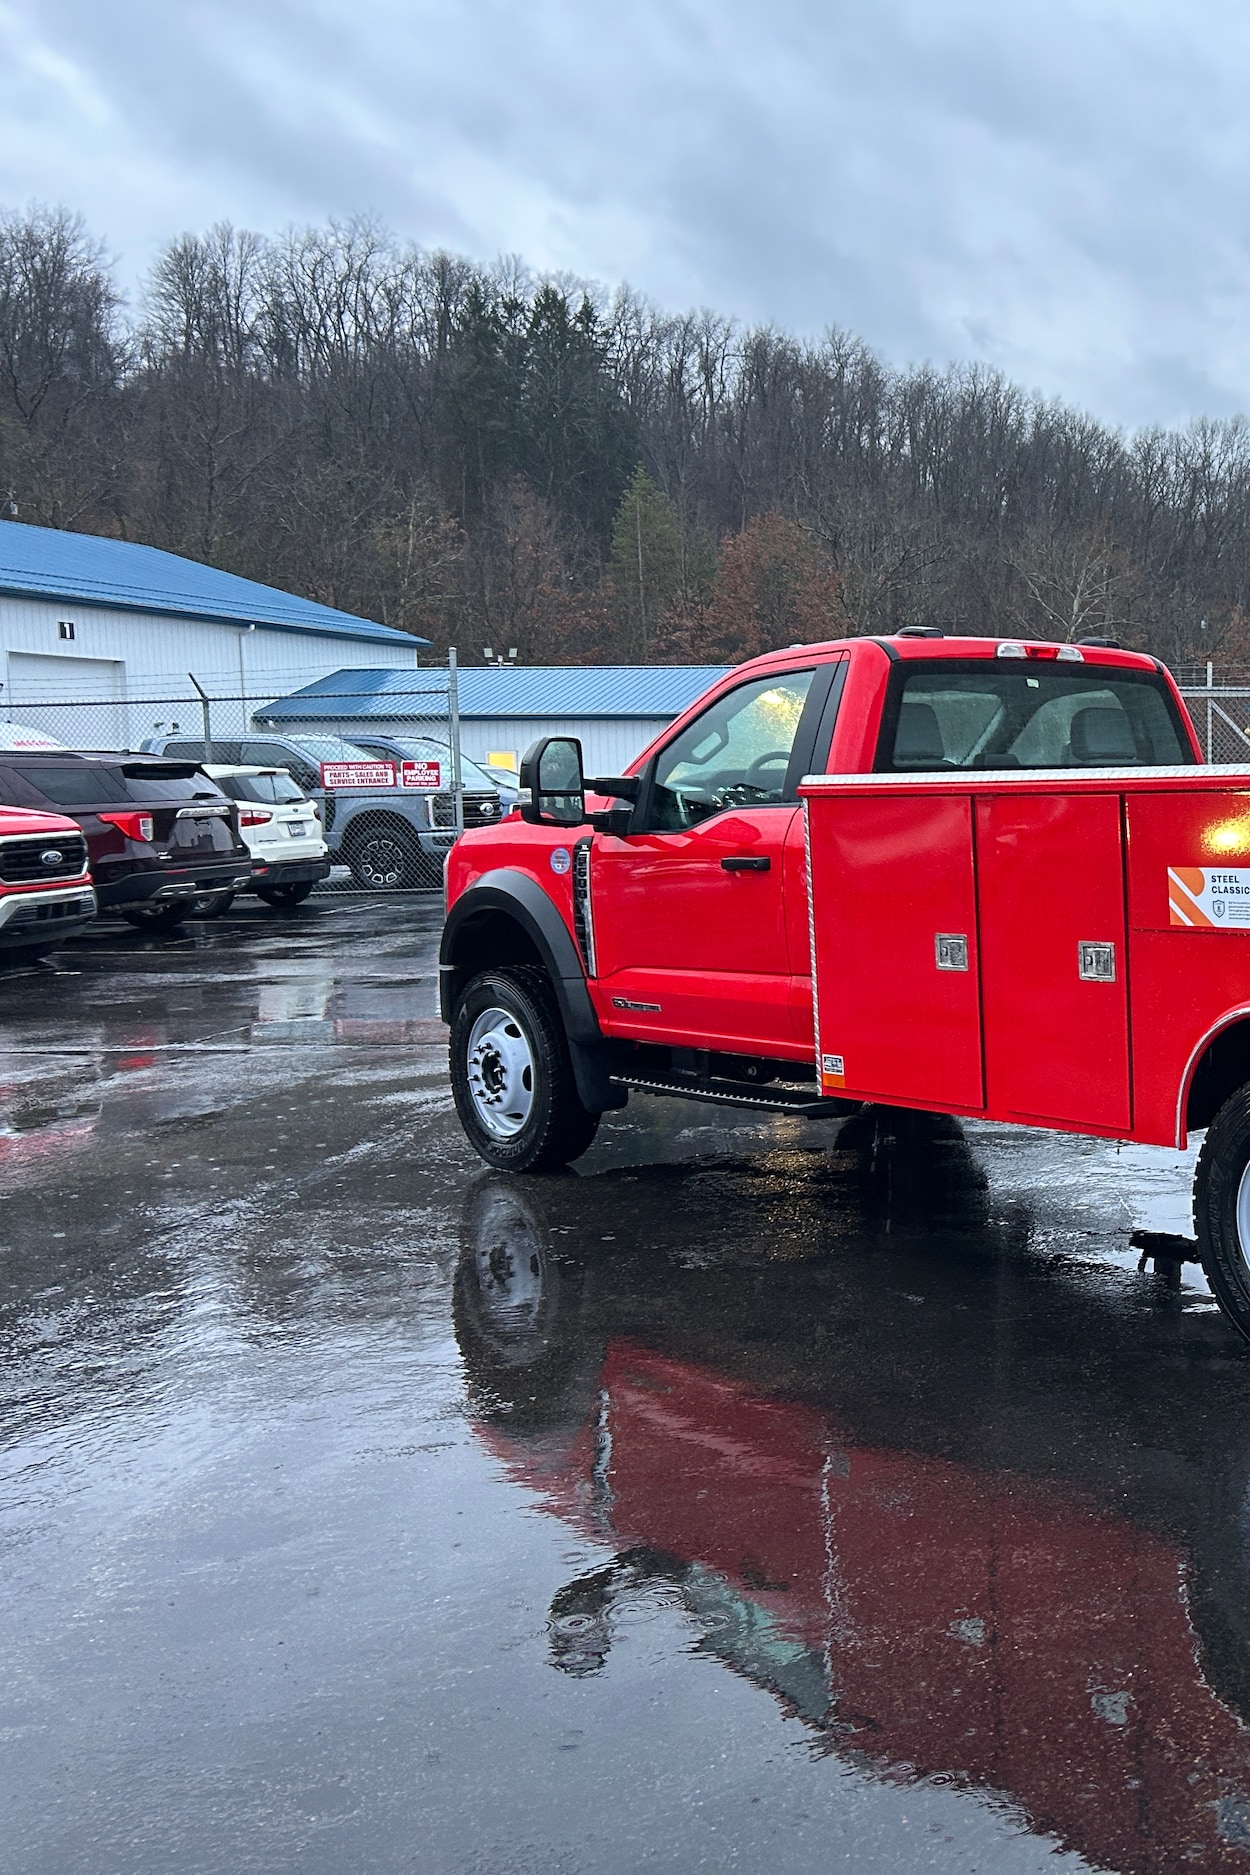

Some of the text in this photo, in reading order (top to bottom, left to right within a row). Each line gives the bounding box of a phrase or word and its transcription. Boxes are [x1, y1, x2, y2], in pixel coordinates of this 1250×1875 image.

[63, 623, 70, 639] 1
[414, 762, 428, 770] NO
[1211, 875, 1240, 883] STEEL
[1211, 886, 1250, 894] CLASSIC
